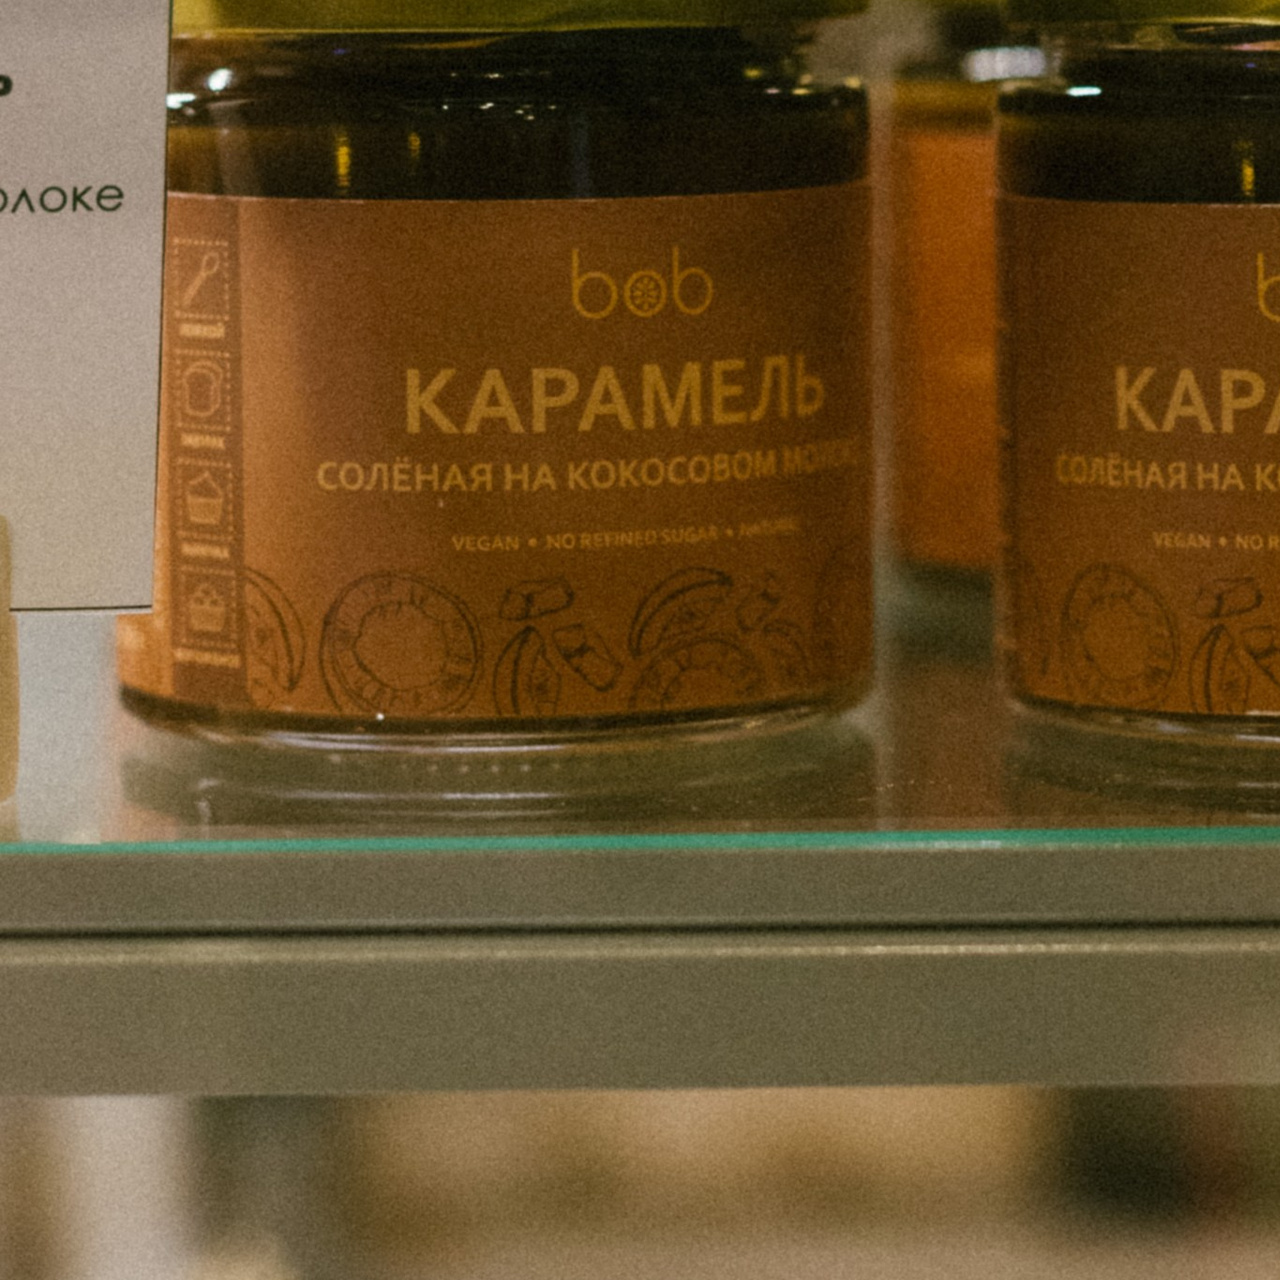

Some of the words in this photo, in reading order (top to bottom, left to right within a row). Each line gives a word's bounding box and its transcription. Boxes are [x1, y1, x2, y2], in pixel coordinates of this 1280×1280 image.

[0, 184, 125, 214] локе
[571, 246, 714, 319] bob
[404, 352, 826, 436] КАРАМЕЛЬ
[316, 454, 493, 492] СОЛЁНАЯ
[503, 464, 557, 492] НА
[567, 448, 776, 490] КОКОСОВОМ
[1055, 452, 1188, 490] СОЛЁНАЯ
[1197, 463, 1246, 491] НА
[451, 535, 520, 552] VEGAN
[546, 532, 576, 550] NO
[581, 528, 657, 548] REFINED
[661, 524, 719, 544] SUGAR
[1153, 531, 1211, 549] VEGAN
[1235, 534, 1264, 550] NO
